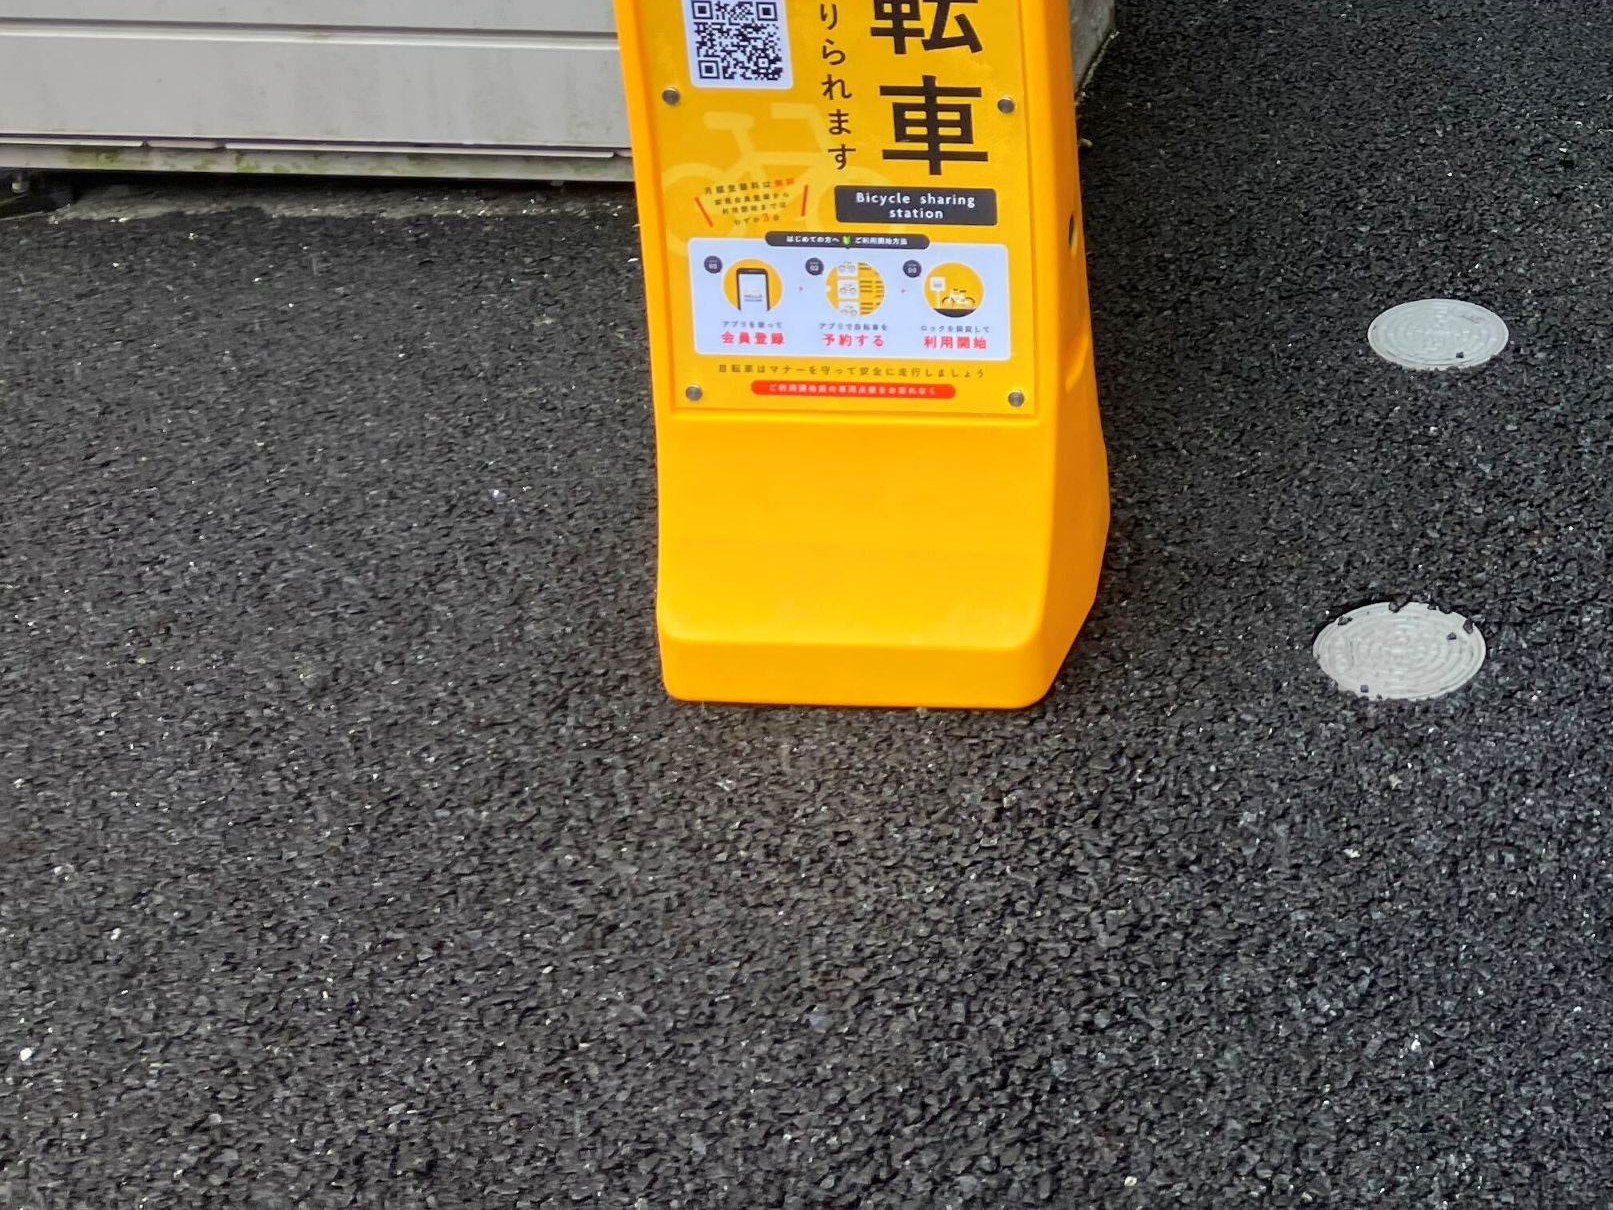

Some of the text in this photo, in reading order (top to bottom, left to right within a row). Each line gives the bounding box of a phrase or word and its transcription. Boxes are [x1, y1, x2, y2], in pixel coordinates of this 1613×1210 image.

[855, 192, 976, 208] Bicycle sharing
[889, 207, 944, 219] station
[786, 235, 840, 244] はじめての方へ
[721, 331, 785, 345] 会員登録
[822, 333, 885, 347] 予約する
[923, 335, 987, 350] 利用開始
